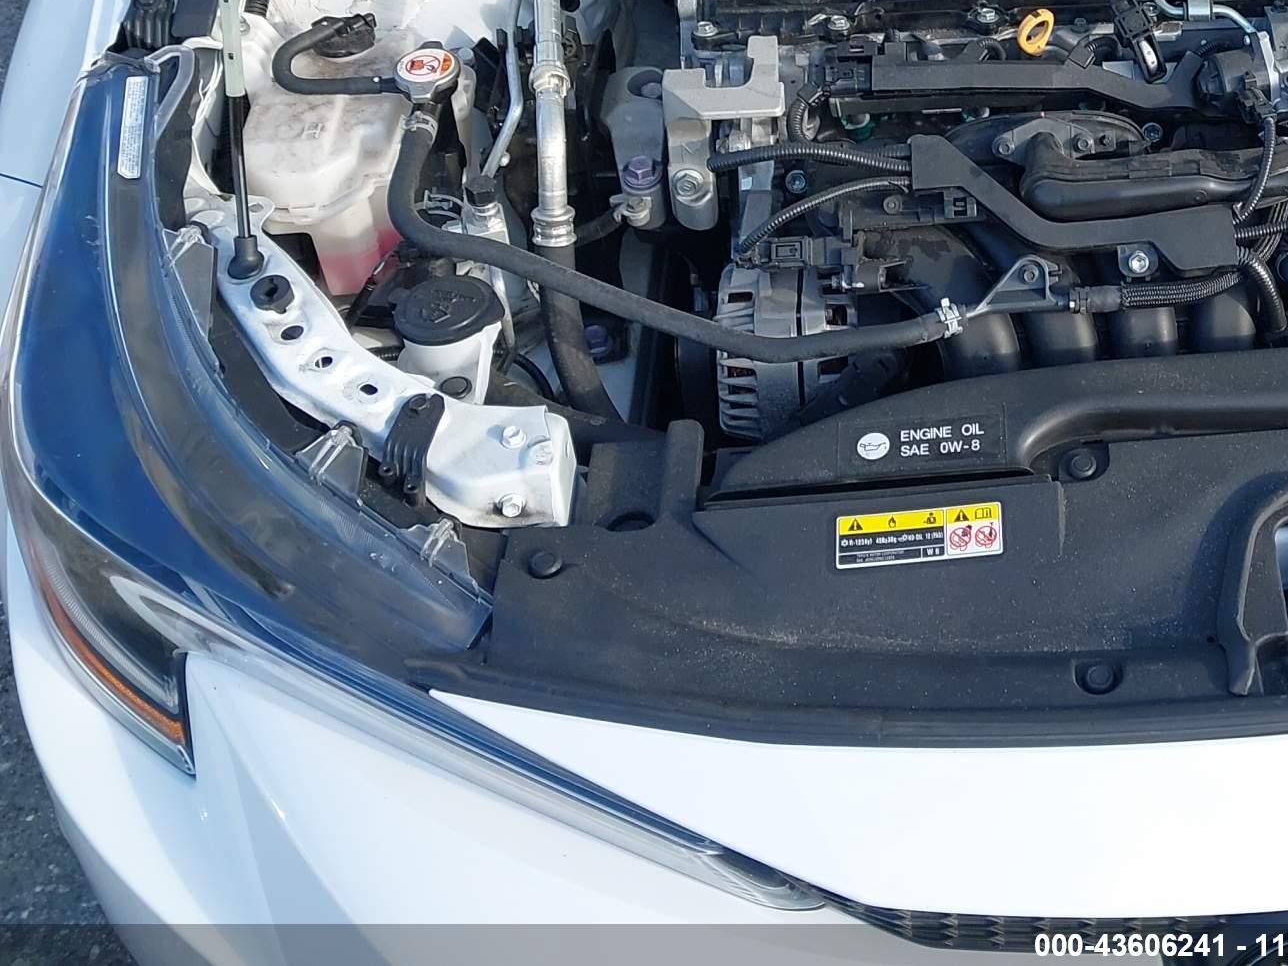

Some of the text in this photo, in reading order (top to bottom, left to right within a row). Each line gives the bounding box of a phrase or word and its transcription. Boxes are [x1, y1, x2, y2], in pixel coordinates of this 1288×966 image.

[900, 423, 985, 442] ENGINE OIL
[900, 439, 981, 457] SAE 0W-8
